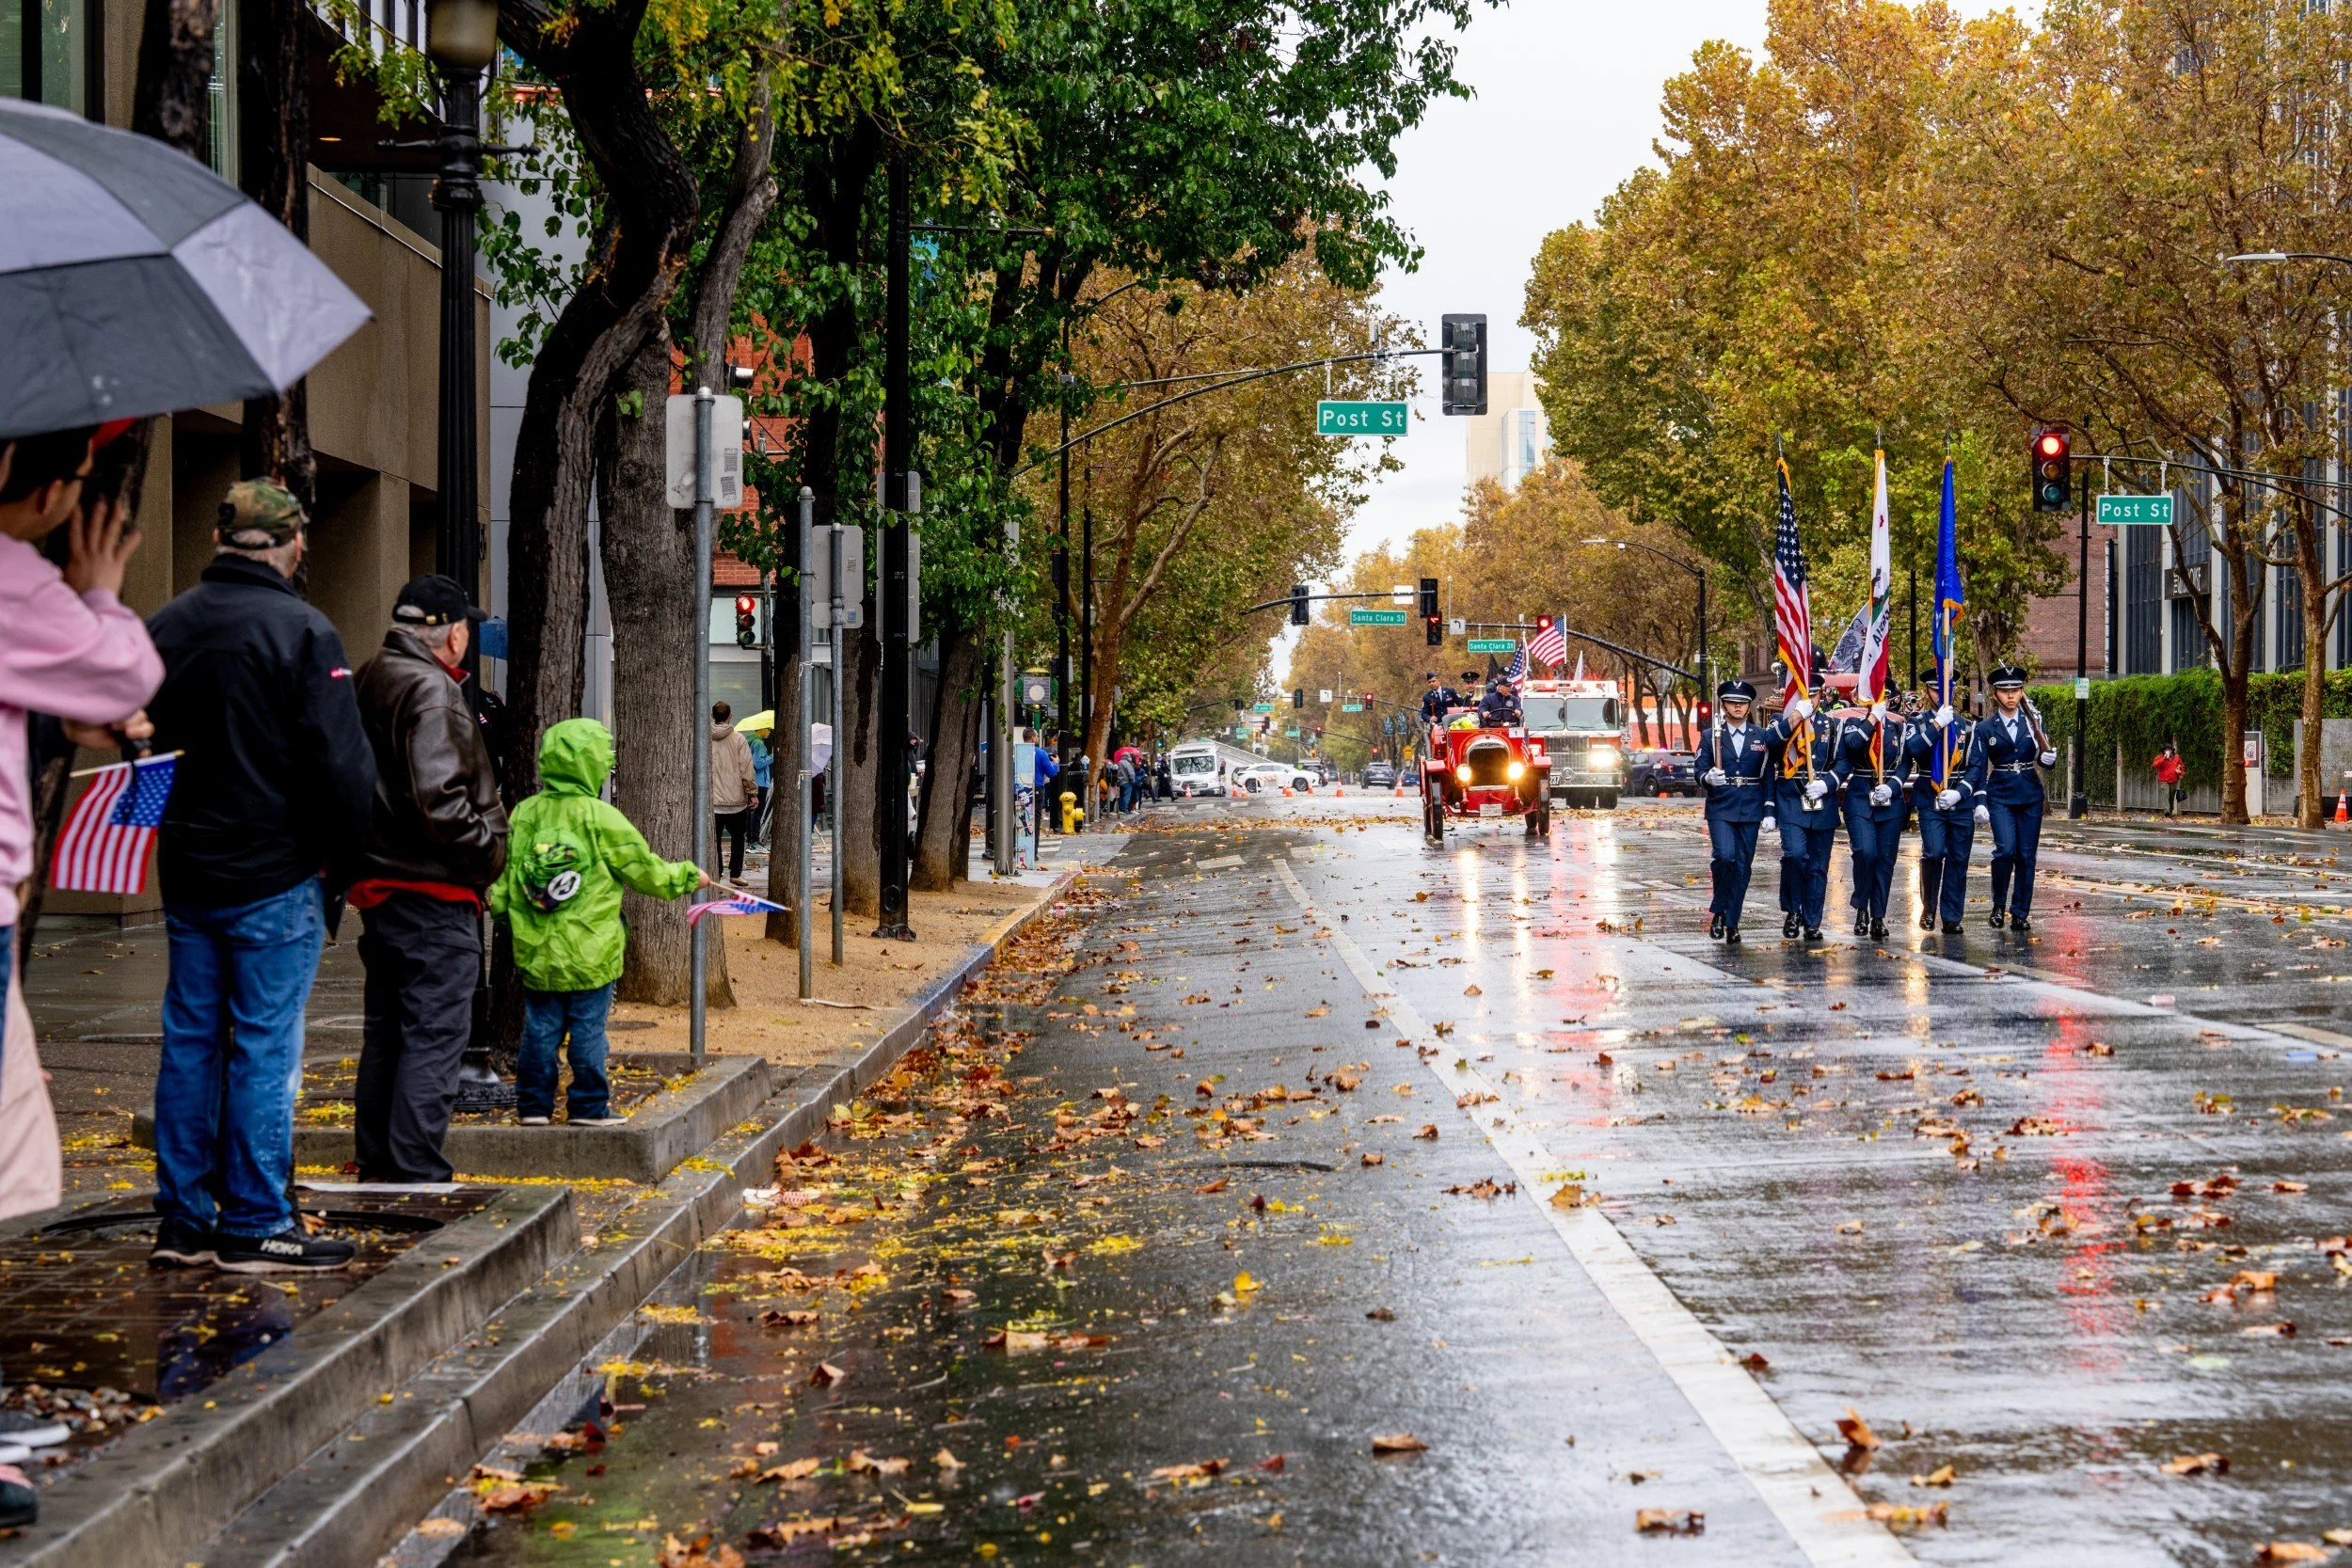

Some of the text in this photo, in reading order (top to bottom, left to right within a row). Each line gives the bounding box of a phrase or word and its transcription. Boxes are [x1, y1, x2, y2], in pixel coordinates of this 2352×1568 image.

[1323, 409, 1403, 427] Post St
[2101, 502, 2169, 517] Post St
[1352, 613, 1373, 622] Santa
[260, 1239, 303, 1257] HOKA
